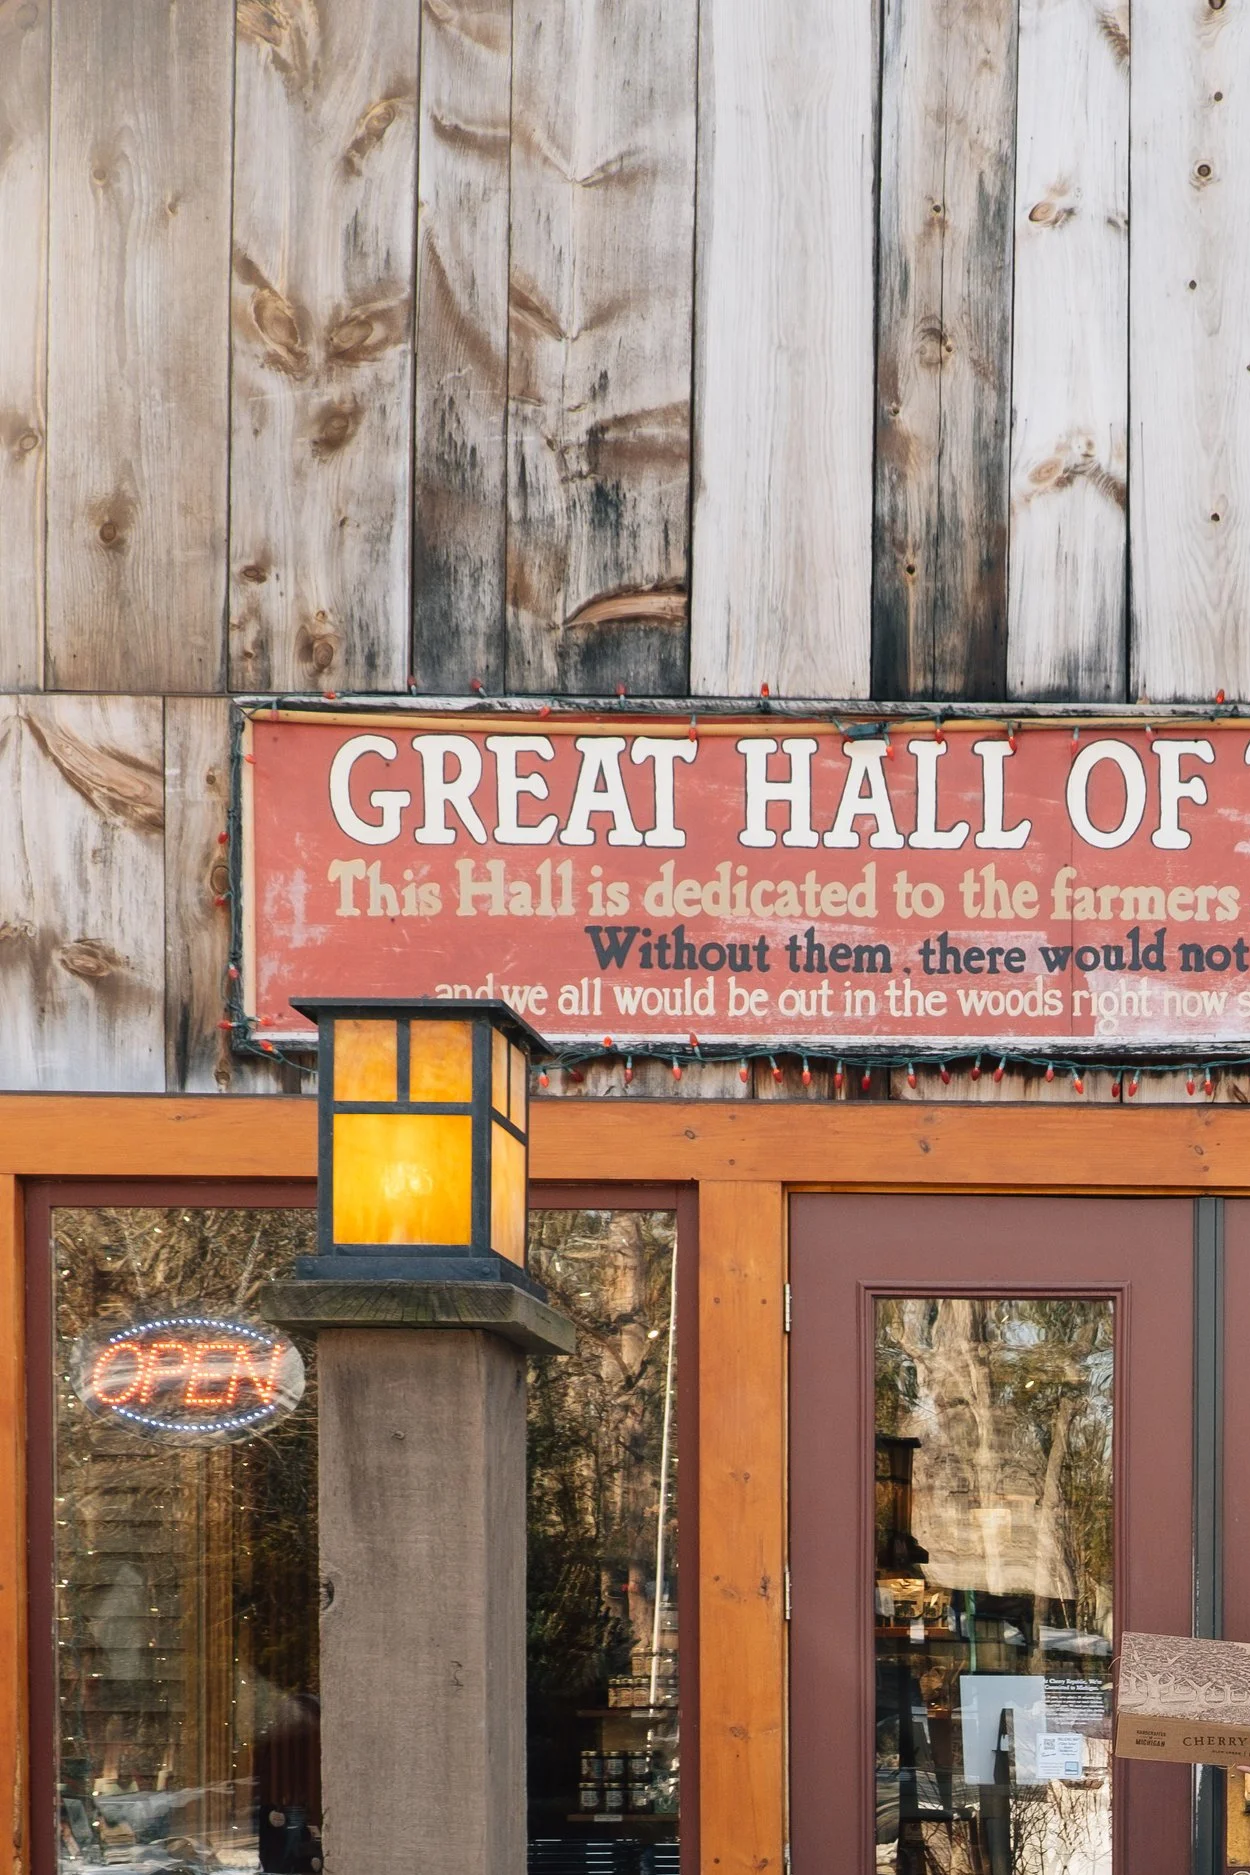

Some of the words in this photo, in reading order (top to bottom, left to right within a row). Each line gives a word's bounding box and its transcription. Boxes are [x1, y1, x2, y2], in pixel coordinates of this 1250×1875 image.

[328, 734, 699, 848] GREAT
[736, 737, 1033, 851] HALL
[1064, 738, 1216, 852] OF
[327, 859, 442, 917] This
[455, 859, 575, 917] Hall
[588, 865, 629, 918] is
[645, 860, 879, 919] dedicated
[893, 869, 945, 919] to
[958, 863, 1039, 920] the
[1051, 866, 1240, 923] farmers
[584, 924, 771, 973] Without
[920, 931, 1025, 975] there
[1039, 926, 1168, 973] would
[1180, 936, 1250, 973] not
[501, 984, 549, 1016] we
[557, 977, 603, 1016] all
[613, 976, 717, 1017] would
[728, 975, 769, 1017] be
[777, 983, 835, 1017] out
[845, 979, 875, 1017] in
[884, 978, 948, 1018] the
[957, 976, 1063, 1018] woods
[1072, 979, 1154, 1035] right
[1164, 990, 1228, 1017] now
[92, 1341, 282, 1406] OPEN
[1182, 1736, 1249, 1747] CHERRY
